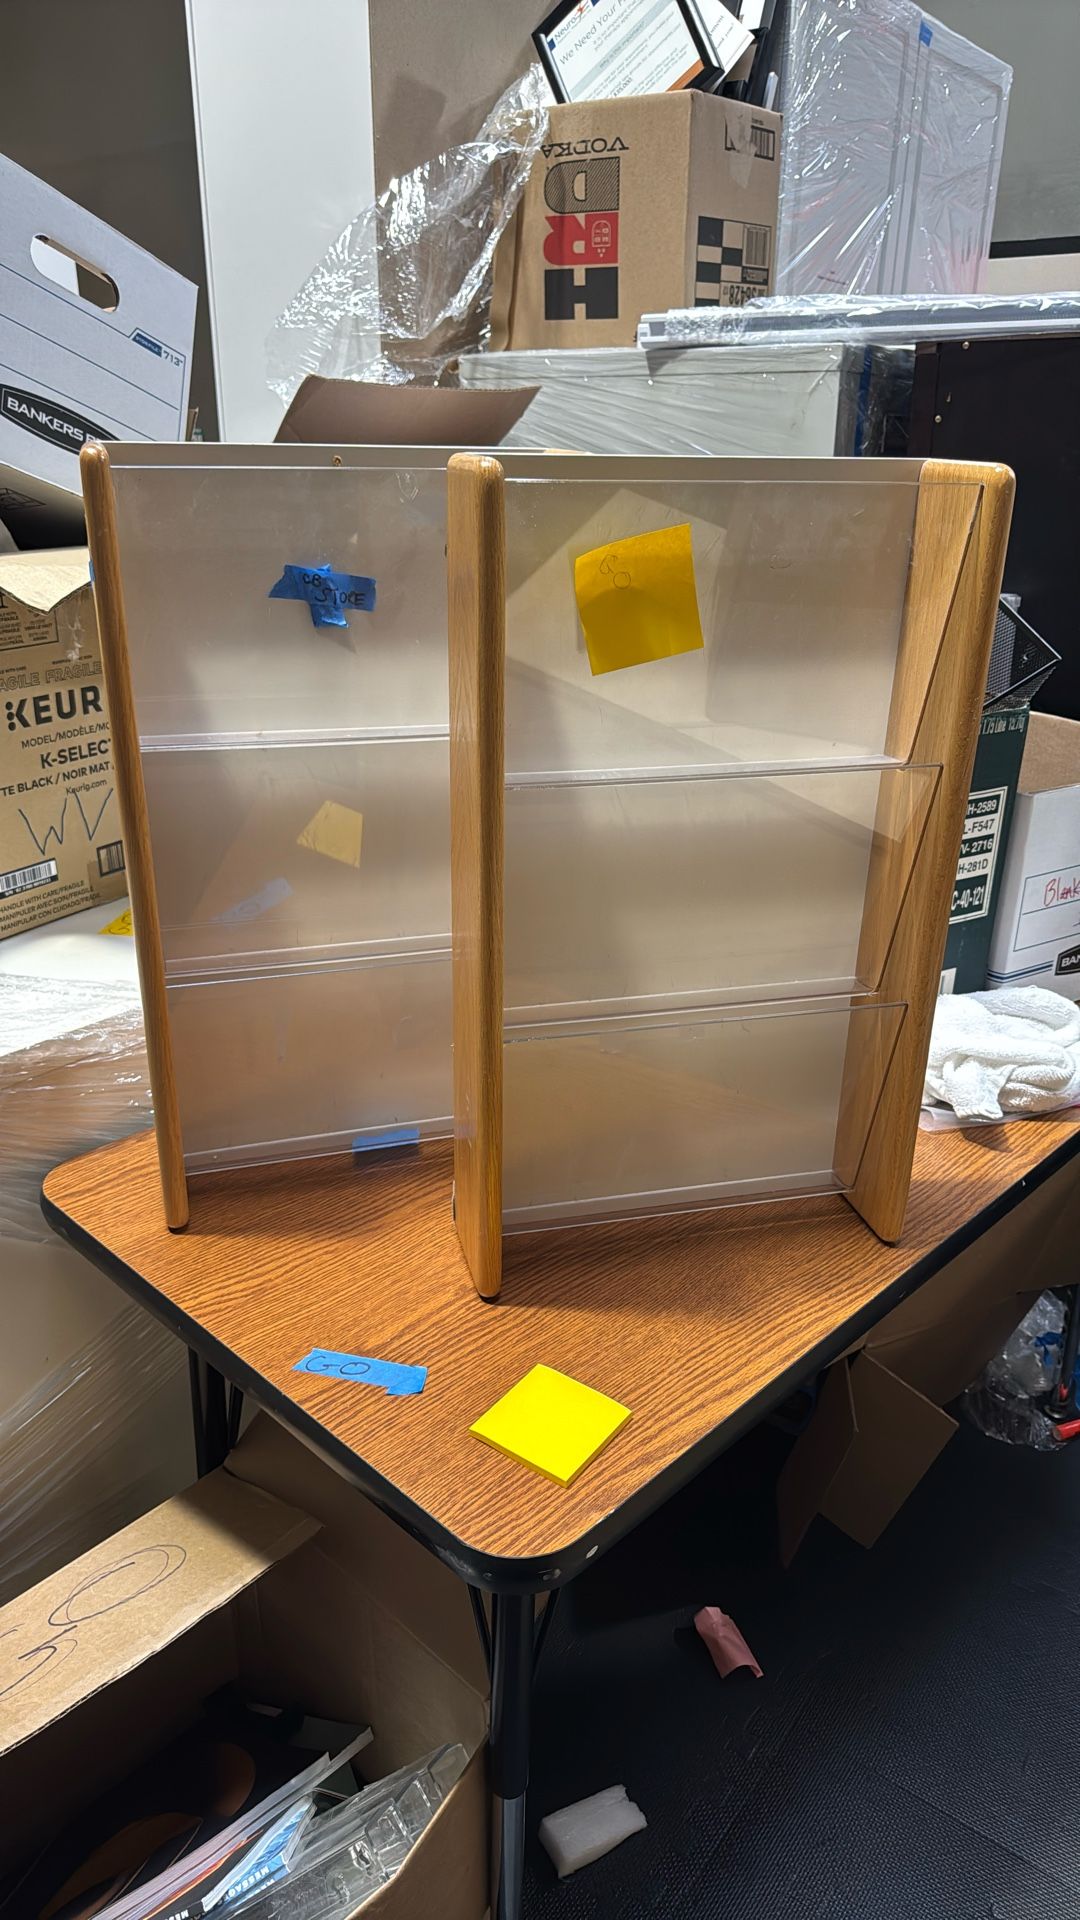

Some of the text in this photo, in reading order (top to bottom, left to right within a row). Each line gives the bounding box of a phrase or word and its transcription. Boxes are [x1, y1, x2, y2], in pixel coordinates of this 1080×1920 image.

[560, 49, 574, 65] We
[574, 24, 598, 51] Need
[598, 6, 617, 27] Your
[540, 136, 629, 158] VODKA
[7, 397, 84, 442] BANKERS
[45, 661, 103, 684] FRAGILE
[40, 738, 111, 769] K-SELEC
[17, 775, 53, 793] BLACK
[62, 767, 87, 781] NOIR
[305, 1355, 371, 1376] GO
